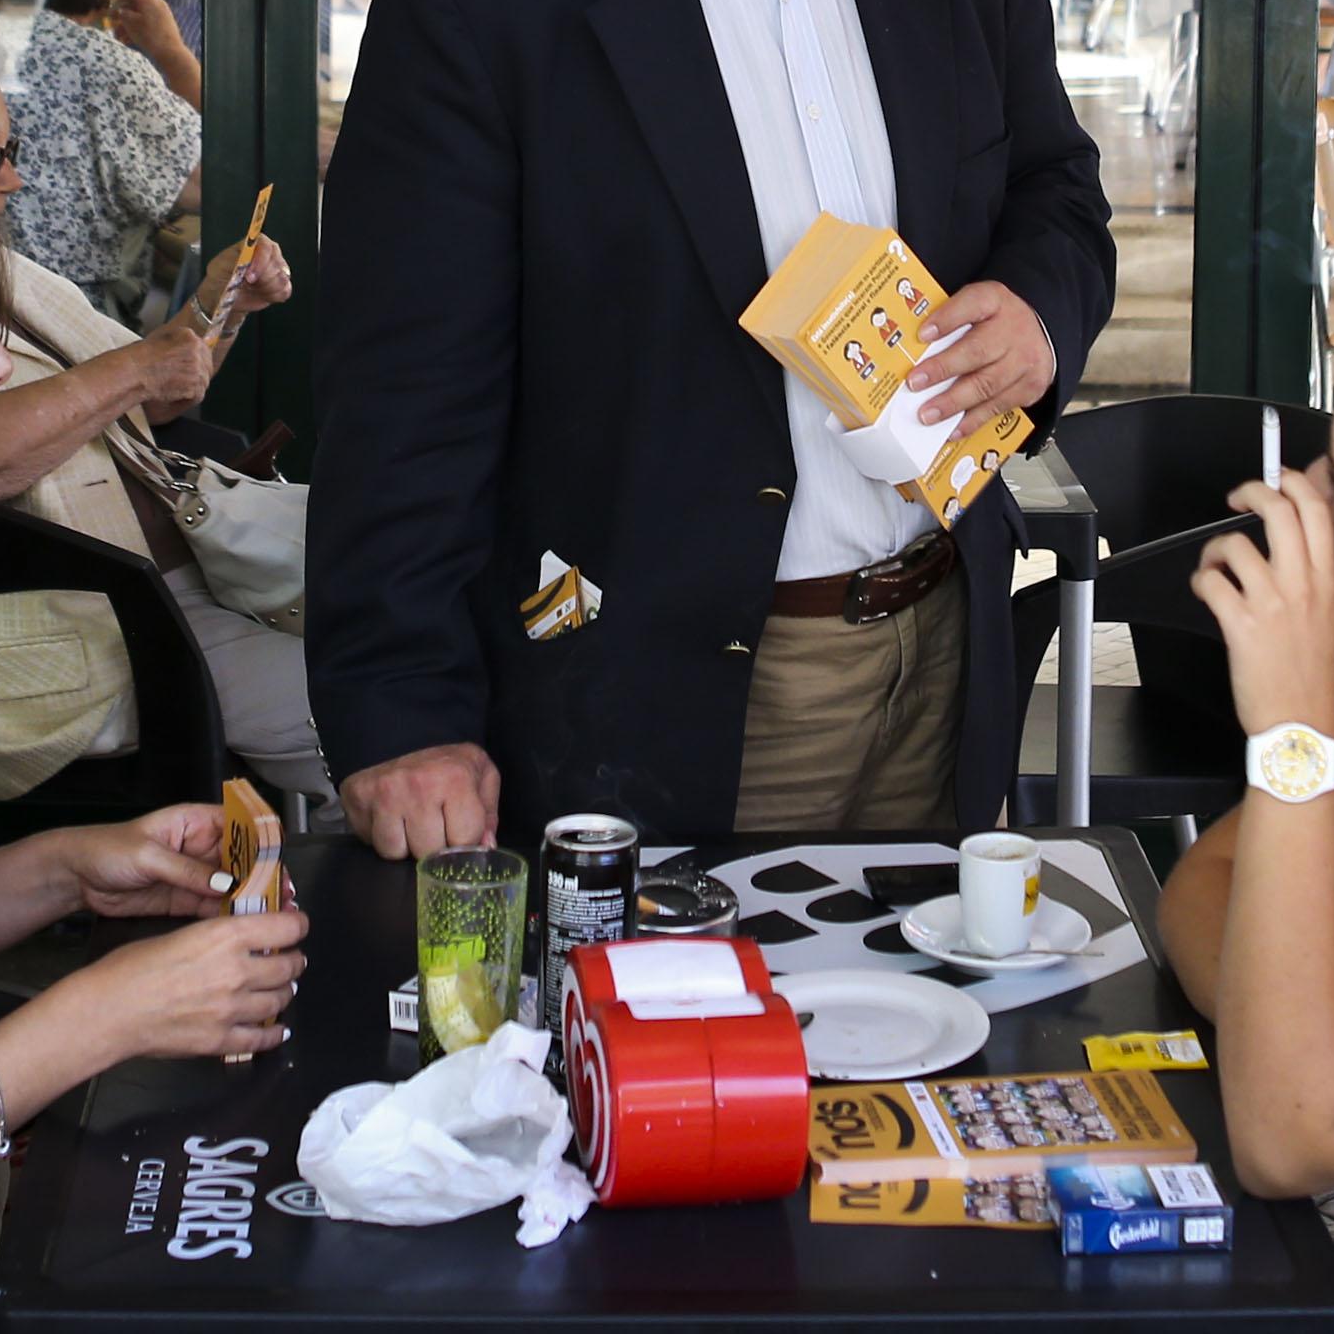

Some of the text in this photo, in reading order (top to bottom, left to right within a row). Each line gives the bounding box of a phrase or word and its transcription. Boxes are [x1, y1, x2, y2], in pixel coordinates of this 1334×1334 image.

[888, 239, 908, 263] ?
[564, 875, 579, 892] ml
[124, 1158, 166, 1235] CERVEJA
[167, 1135, 270, 1261] SAGRES
